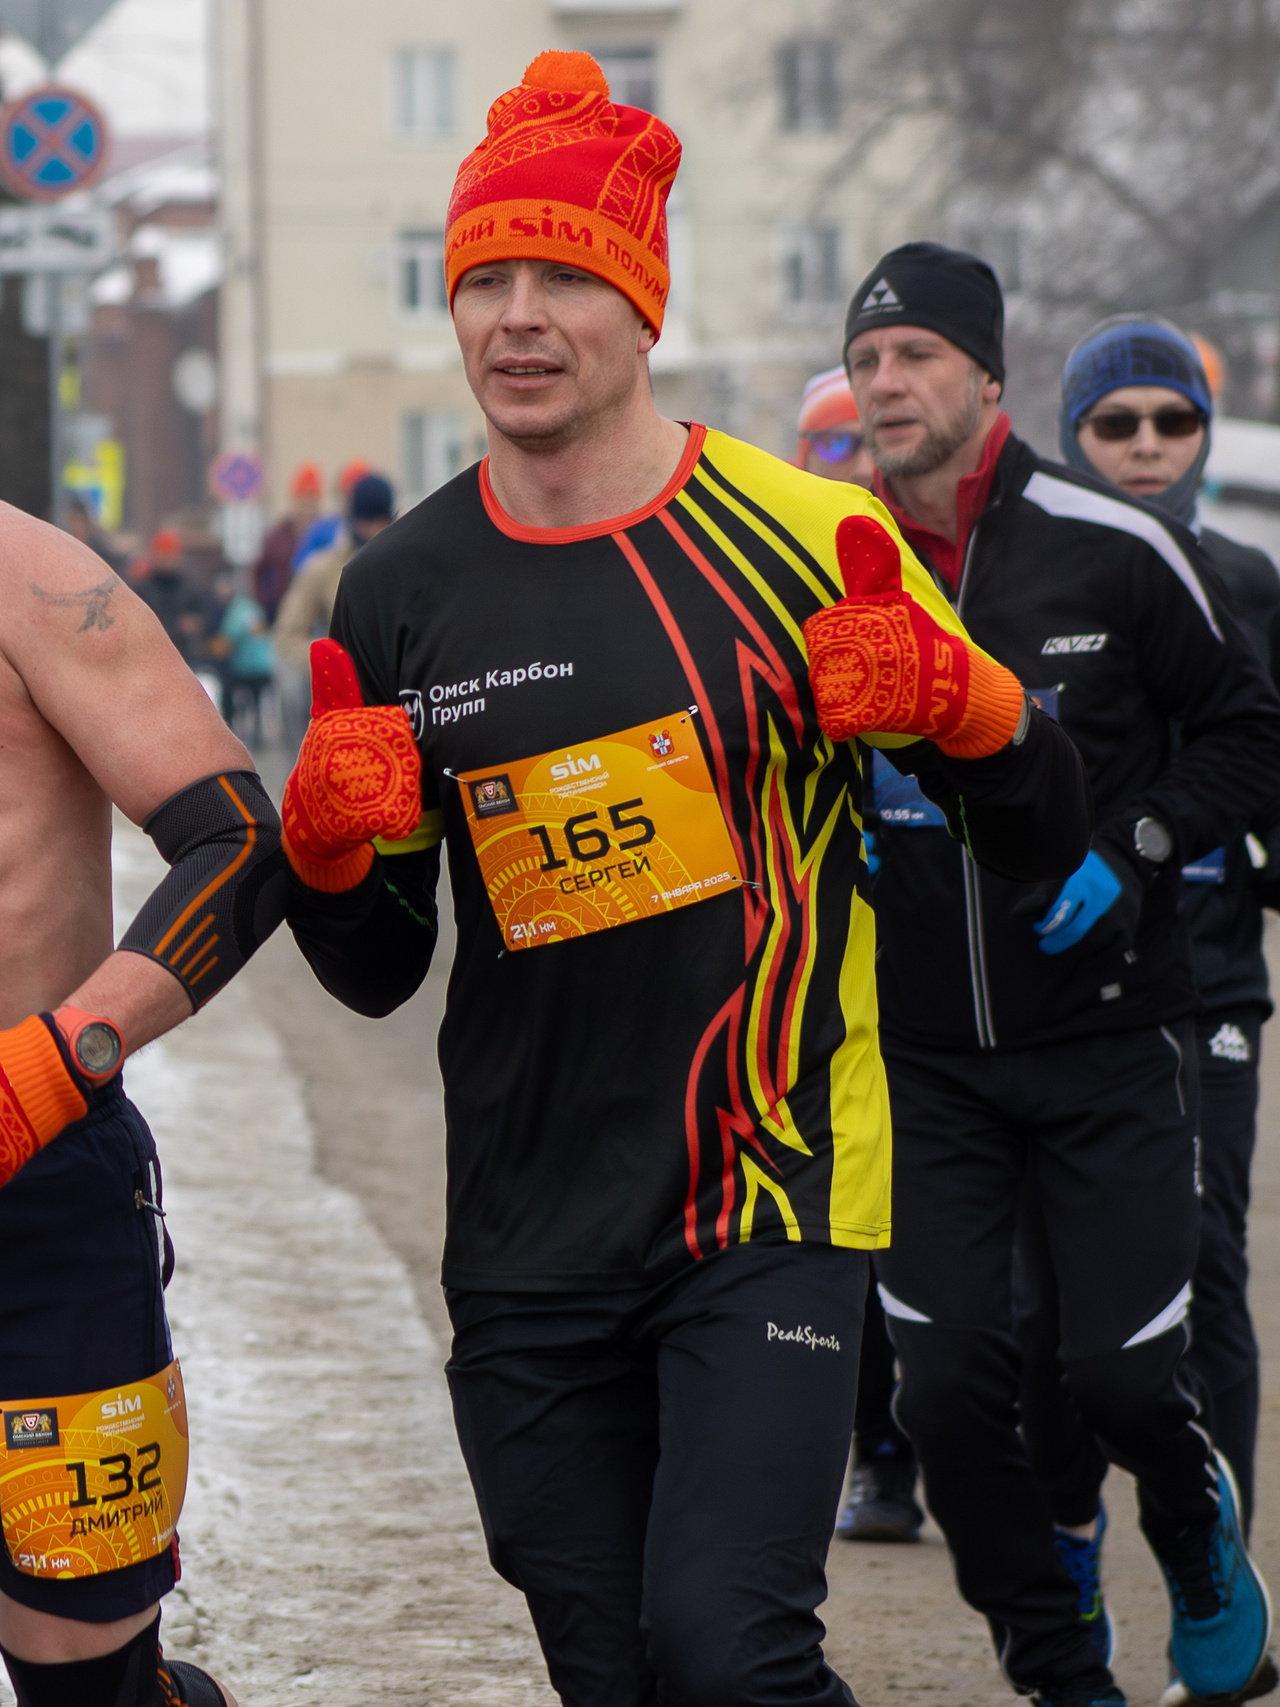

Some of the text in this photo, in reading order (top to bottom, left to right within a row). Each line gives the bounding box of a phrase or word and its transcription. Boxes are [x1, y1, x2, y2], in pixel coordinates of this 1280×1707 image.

[429, 661, 574, 704] Омск Карбон
[431, 698, 486, 726] Групп
[529, 797, 656, 872] 165
[559, 851, 652, 894] СЕРГЕЙ
[651, 871, 731, 904] 7 ЯНВАРЯ 2025
[510, 921, 537, 941] 21,1
[766, 1321, 841, 1352] PeakSports
[66, 1441, 161, 1509] 132
[69, 1489, 164, 1538] ДМИТРИЙ
[19, 1553, 47, 1569] 21,1
